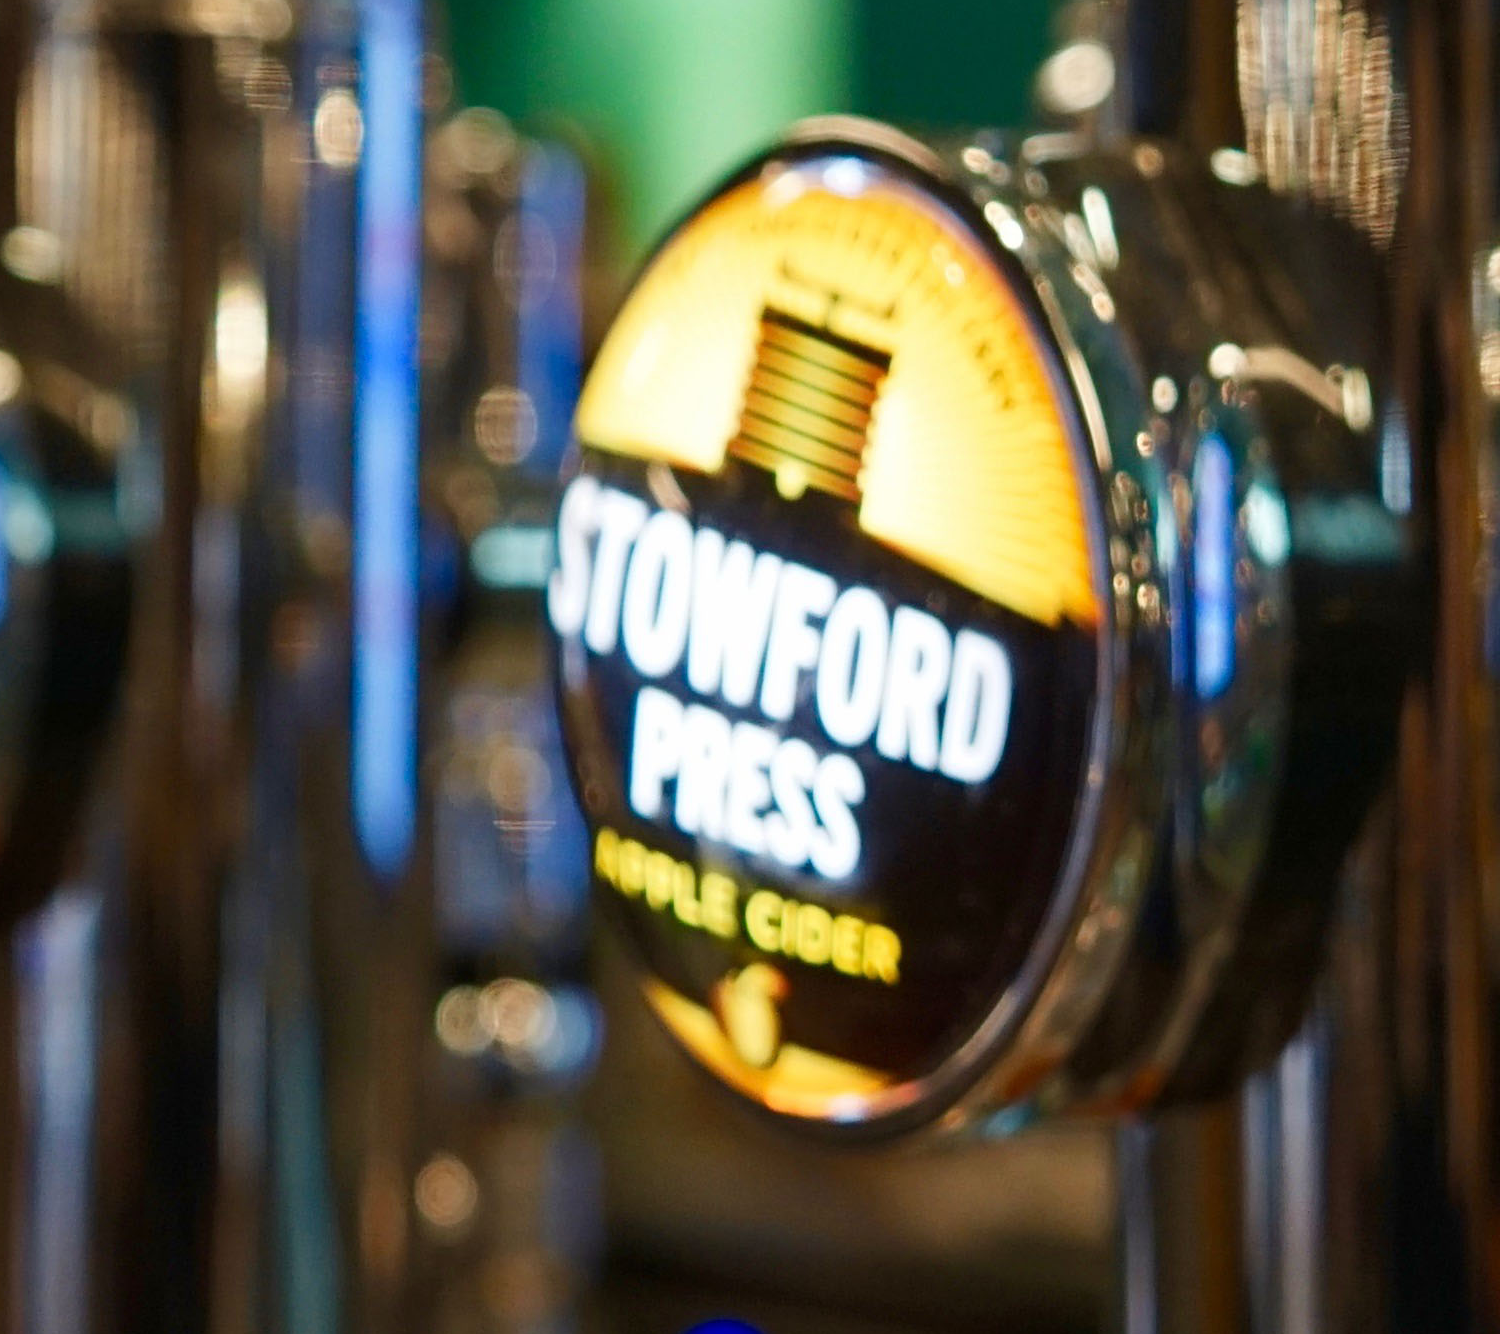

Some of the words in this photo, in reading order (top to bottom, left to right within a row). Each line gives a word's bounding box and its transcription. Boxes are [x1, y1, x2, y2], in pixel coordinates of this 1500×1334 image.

[547, 474, 1014, 785] STOWFORD
[628, 687, 867, 880] PRESS
[595, 827, 739, 938] APPLE
[745, 890, 902, 986] CIDER
